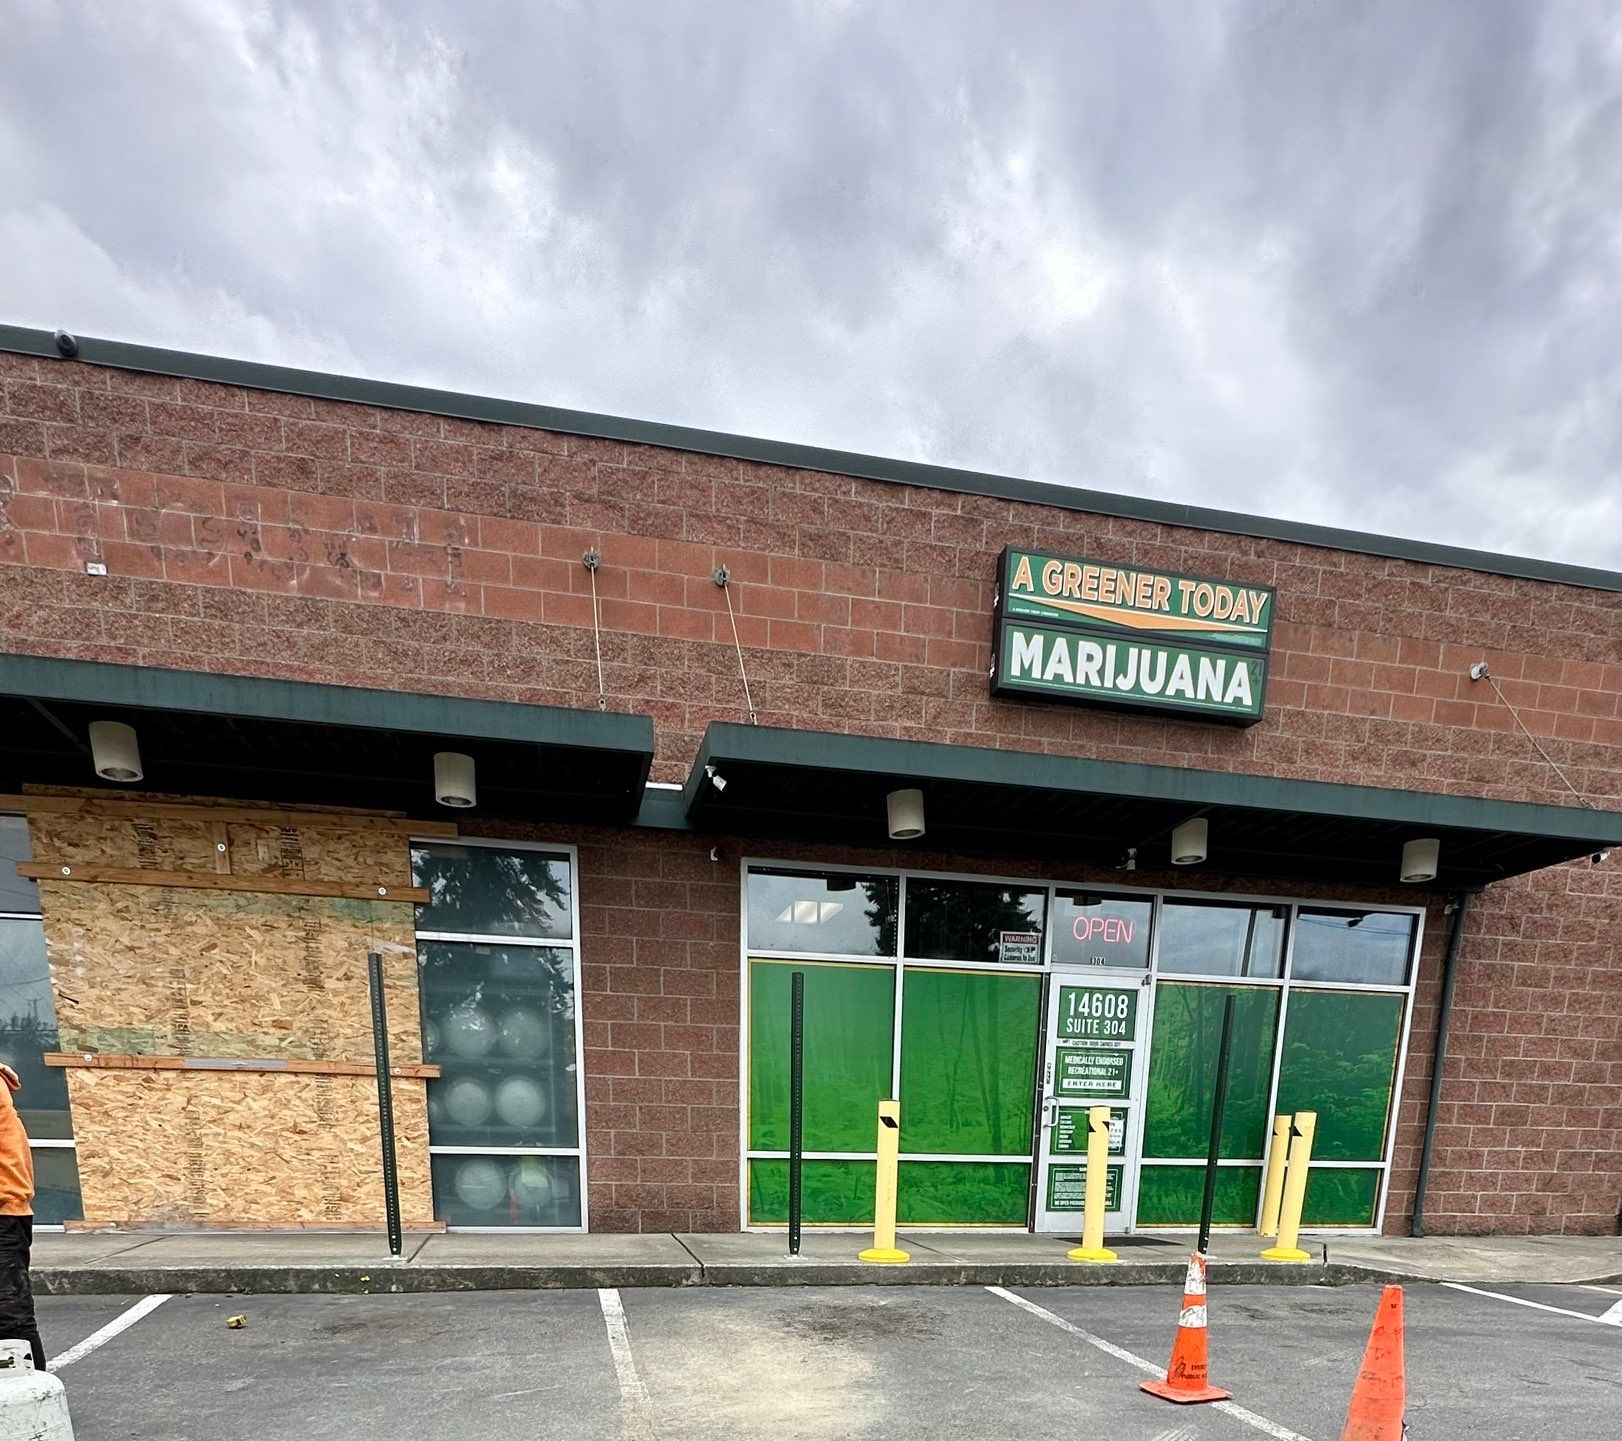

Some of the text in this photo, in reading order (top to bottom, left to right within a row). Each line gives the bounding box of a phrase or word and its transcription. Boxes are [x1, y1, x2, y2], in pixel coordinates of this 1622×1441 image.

[1012, 555, 1268, 624] A GREENER TODAY
[1010, 631, 1253, 706] MARIJUANA
[1004, 935, 1038, 944] WARNING
[1073, 916, 1134, 943] OPEN
[1068, 992, 1129, 1019] 14608
[1066, 1018, 1126, 1036] SUITE 304
[1064, 1055, 1124, 1066] MEDICALLY ENDORSED
[1067, 1066, 1107, 1076] RECREATIONAL
